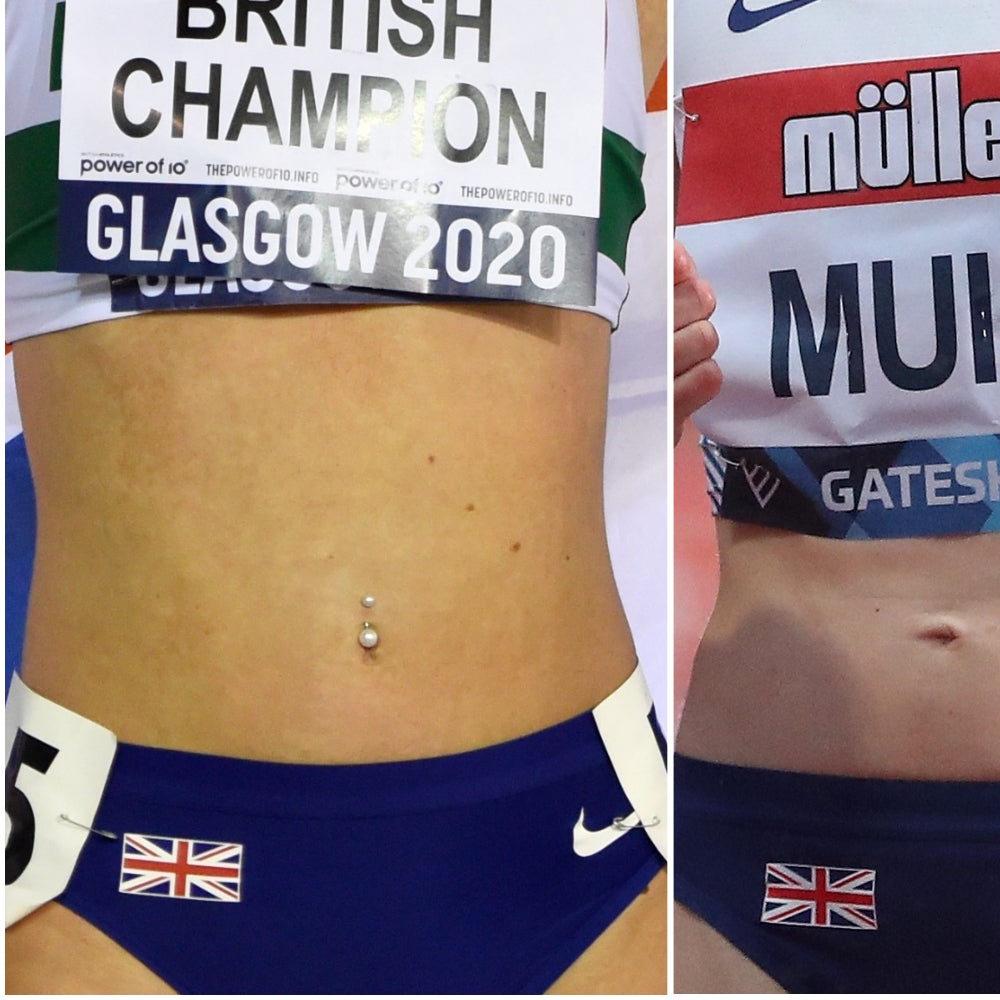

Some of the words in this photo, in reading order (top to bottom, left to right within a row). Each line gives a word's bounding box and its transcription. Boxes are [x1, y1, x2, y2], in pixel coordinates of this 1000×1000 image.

[111, 57, 547, 169] CHAMPION
[80, 158, 143, 176] power
[146, 157, 165, 175] of
[206, 163, 319, 184] THEPOWEROF10.INFO
[335, 173, 398, 191] power
[460, 185, 574, 207] THEPOWEROF10.INFO
[86, 193, 388, 275] GLASGOW
[403, 215, 567, 290] 2020
